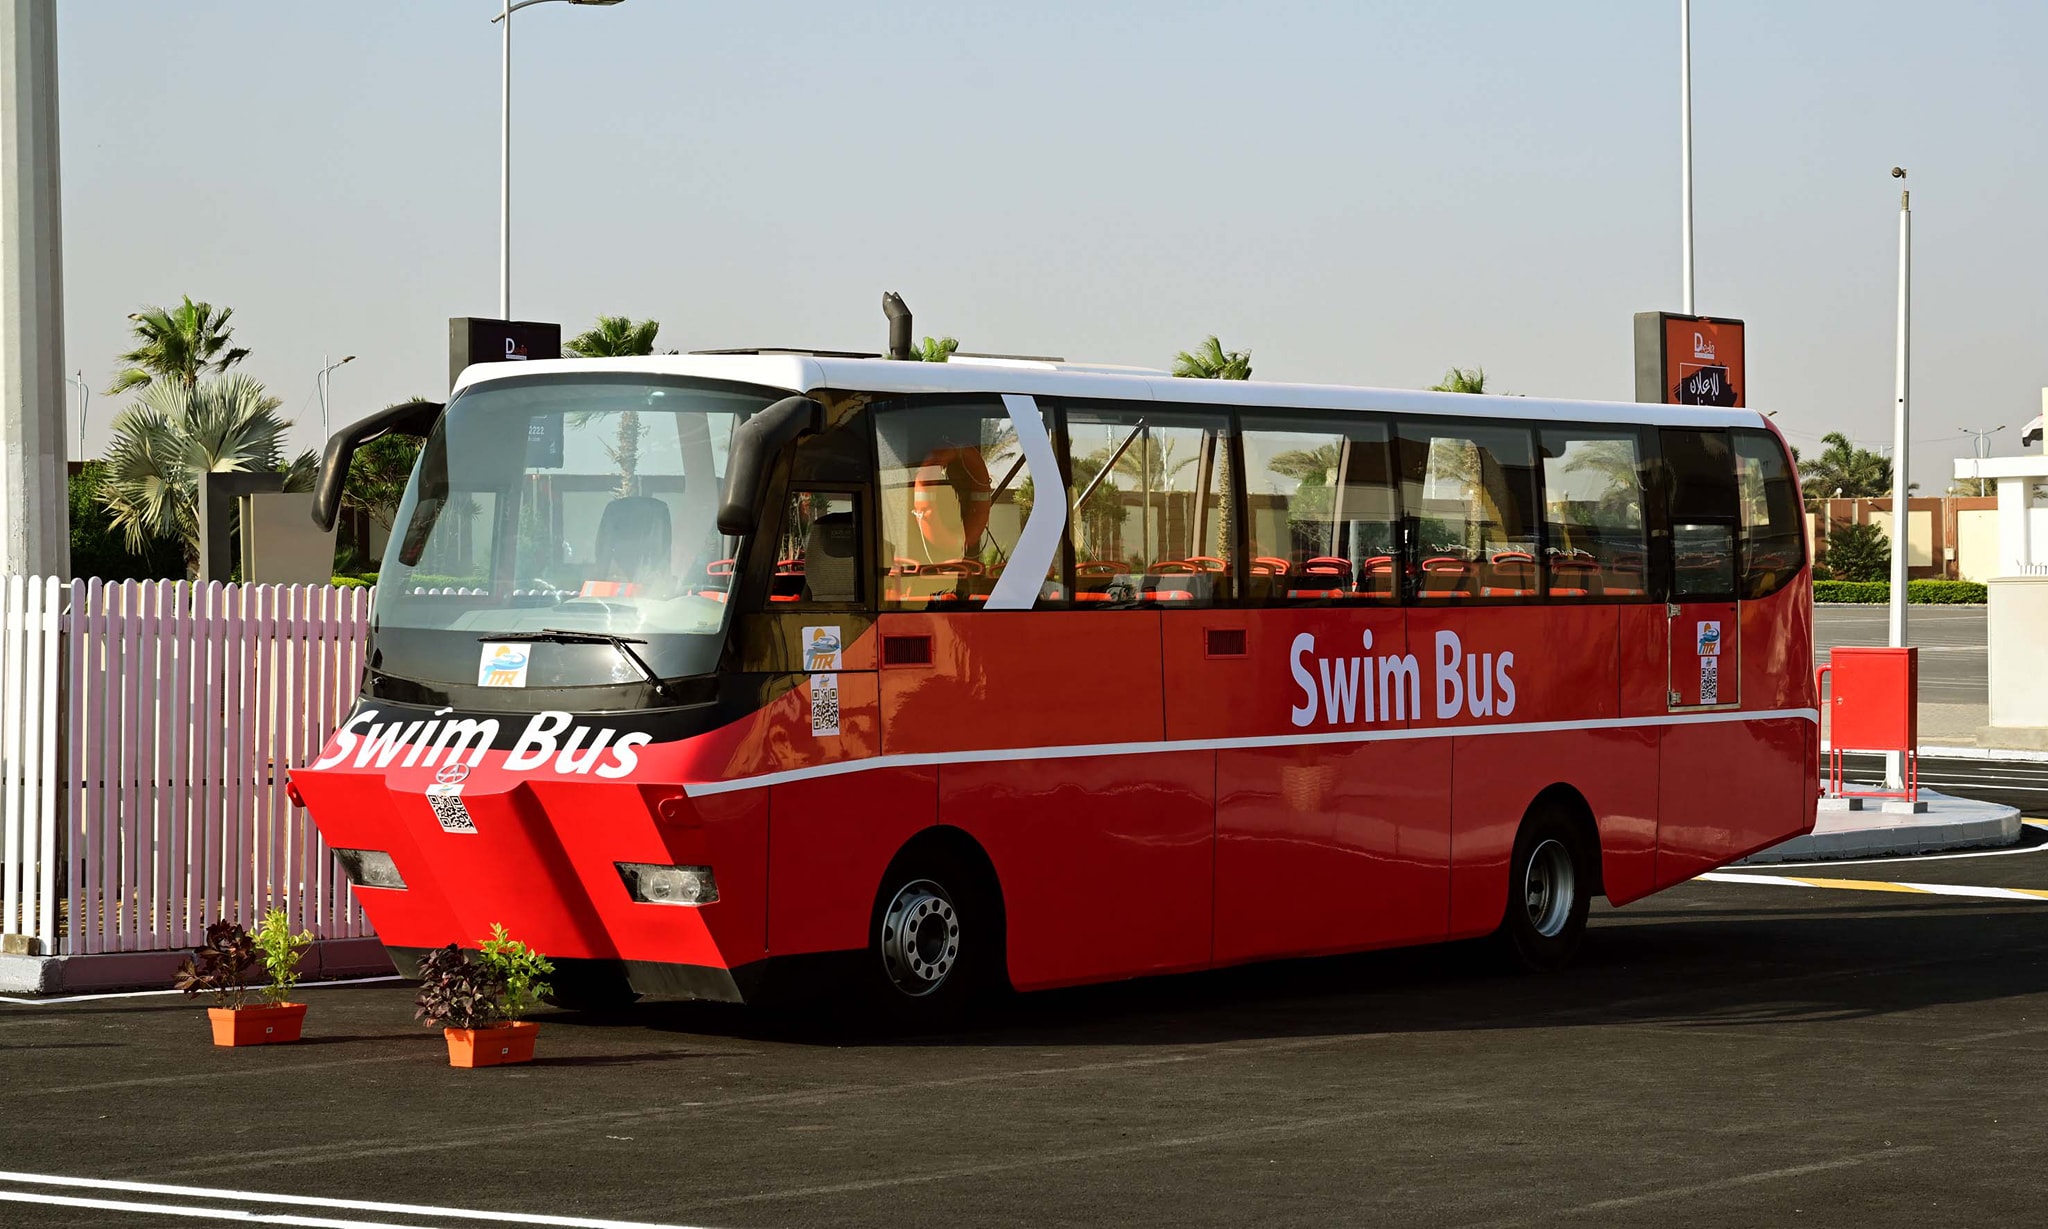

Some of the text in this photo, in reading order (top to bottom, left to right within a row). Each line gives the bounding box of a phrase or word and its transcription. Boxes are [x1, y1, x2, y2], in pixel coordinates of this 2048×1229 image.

[1290, 628, 1516, 727] Swim Bus
[312, 706, 653, 778] Swim Bus
